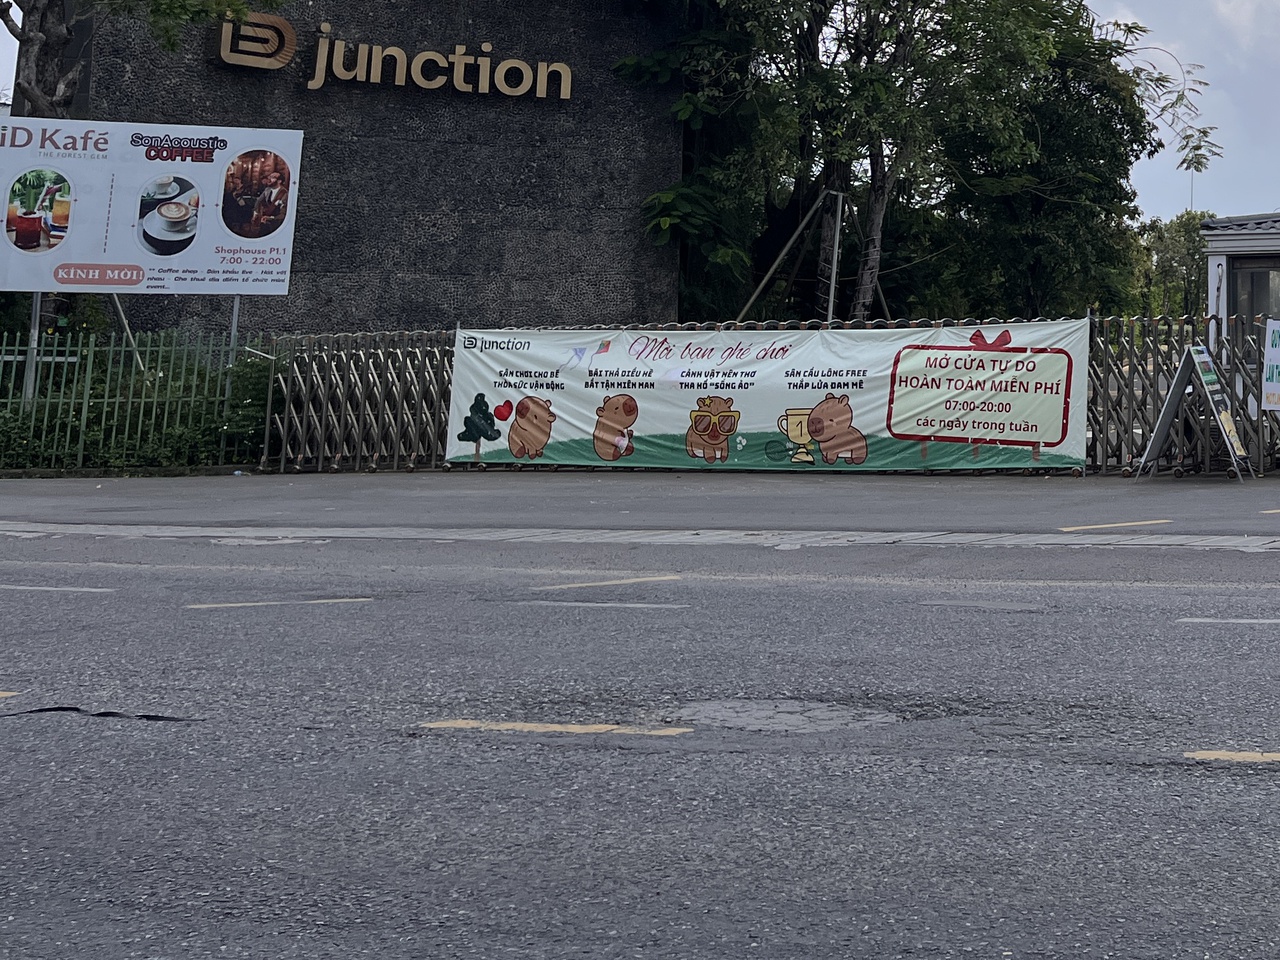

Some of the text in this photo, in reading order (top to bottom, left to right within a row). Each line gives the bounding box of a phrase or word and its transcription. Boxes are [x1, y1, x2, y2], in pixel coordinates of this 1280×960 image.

[307, 22, 572, 100] junction
[39, 128, 109, 153] Kafé
[130, 132, 228, 151] SonAcoustic
[56, 151, 87, 159] FOREST
[145, 146, 215, 163] COFFEE
[214, 246, 286, 256] Shophouse P1.1
[219, 256, 243, 265] 7:00
[251, 257, 282, 266] 22:00
[57, 266, 143, 281] KÍNH MỜI!
[480, 337, 531, 353] junction
[628, 335, 793, 366] Mời bạn ghé chơi
[924, 353, 1037, 375] MỞ CỬA TỰ DO
[498, 368, 514, 378] SÂN
[515, 370, 533, 379] CHƠI
[533, 370, 549, 379] CHO
[588, 368, 604, 378] BÃI
[604, 367, 620, 378] THẢ
[680, 368, 758, 379] CẢNH VẬT NÊN THƠ
[784, 368, 802, 378] SÂN
[821, 367, 845, 378] LÔNG
[845, 369, 868, 378] FREE
[529, 380, 545, 391] VẬN
[545, 380, 566, 391] ĐỘNG
[584, 377, 600, 389] BẤT
[600, 379, 616, 391] TẬN
[638, 381, 656, 390] MAN
[679, 382, 696, 390] THA
[811, 379, 829, 390] LỬA
[830, 381, 850, 390] ĐAM
[851, 379, 865, 390] MÊ
[898, 374, 1062, 395] HOÀN TOÀN MIỄN PHÍ
[944, 400, 1012, 413] 07:00-20:00
[916, 416, 1038, 433] các ngày trong tuần
